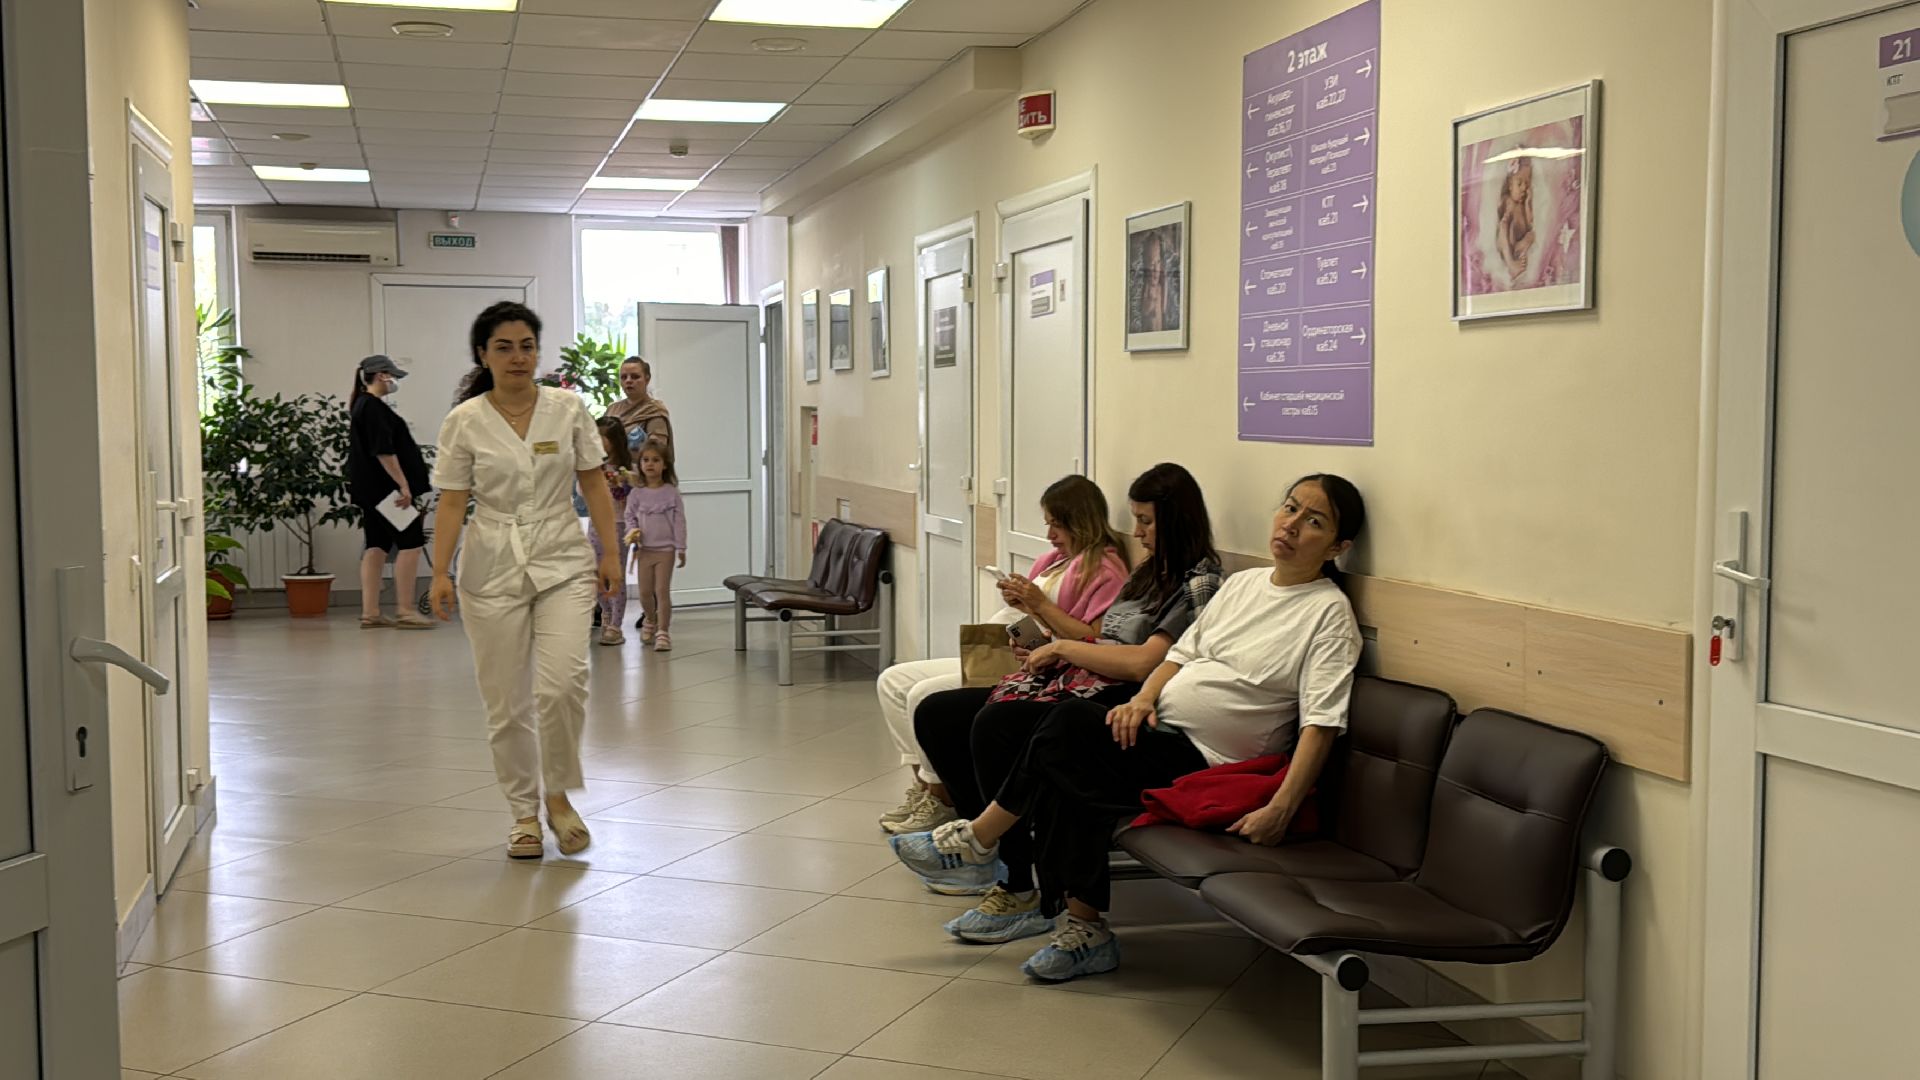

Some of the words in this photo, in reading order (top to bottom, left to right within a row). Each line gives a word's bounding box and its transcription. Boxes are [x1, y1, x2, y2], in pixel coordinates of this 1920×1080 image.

[1892, 37, 1911, 60] 21
[1288, 50, 1295, 73] 2
[1297, 42, 1328, 69] этаж
[1324, 74, 1339, 90] УЗИ
[1322, 195, 1336, 208] КТГ
[434, 236, 473, 247] ВЫХОД
[1316, 257, 1339, 271] Туалет
